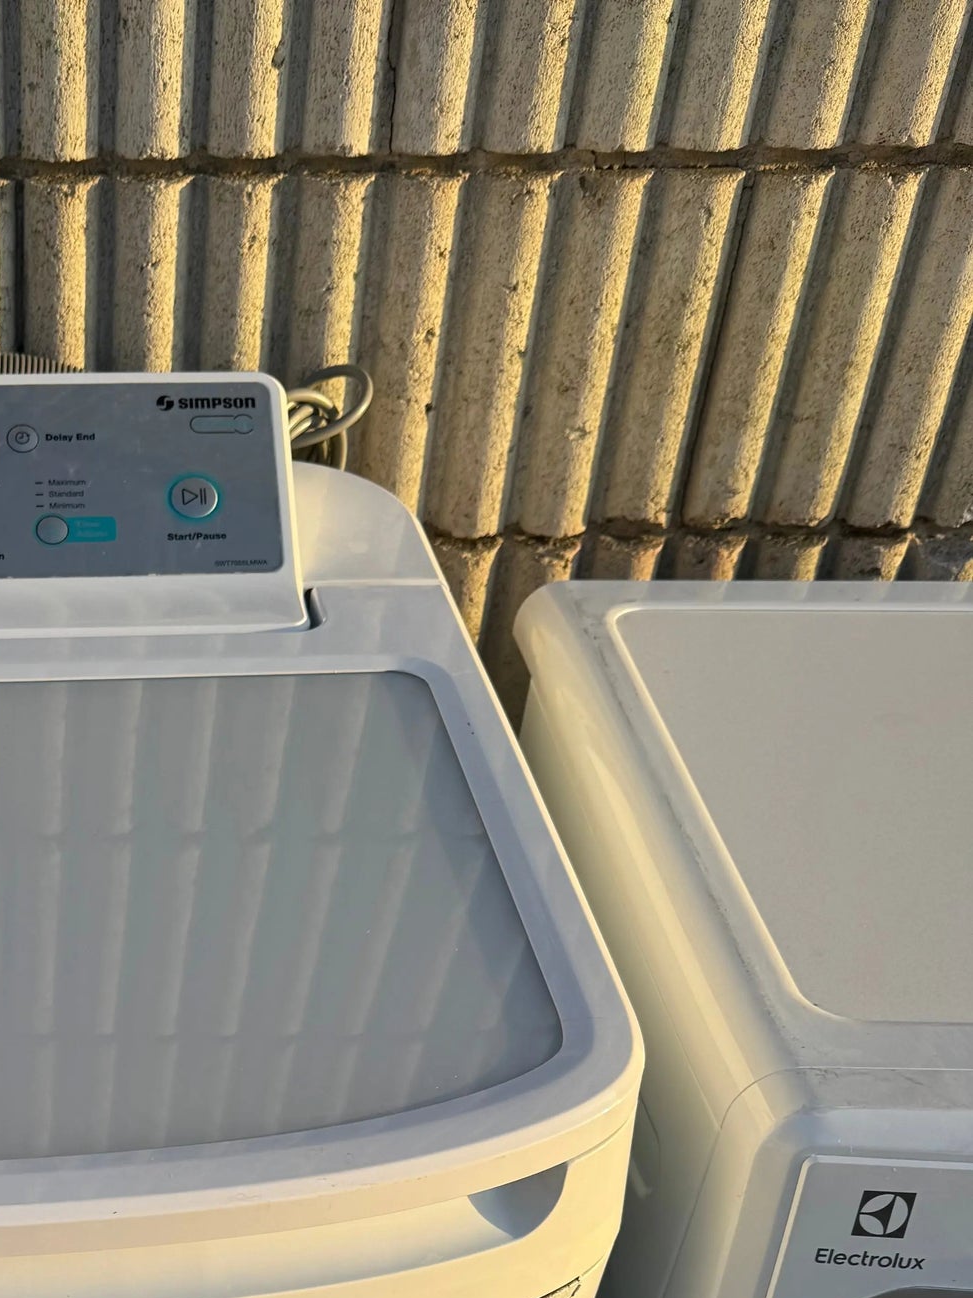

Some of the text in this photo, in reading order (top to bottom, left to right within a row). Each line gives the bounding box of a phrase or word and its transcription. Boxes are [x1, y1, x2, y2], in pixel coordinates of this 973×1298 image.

[45, 433, 96, 442] Delay End
[48, 490, 85, 498] Standard
[49, 502, 86, 510] Minimum
[167, 532, 227, 541] Start/Pause
[814, 1247, 927, 1270] Electrolux
